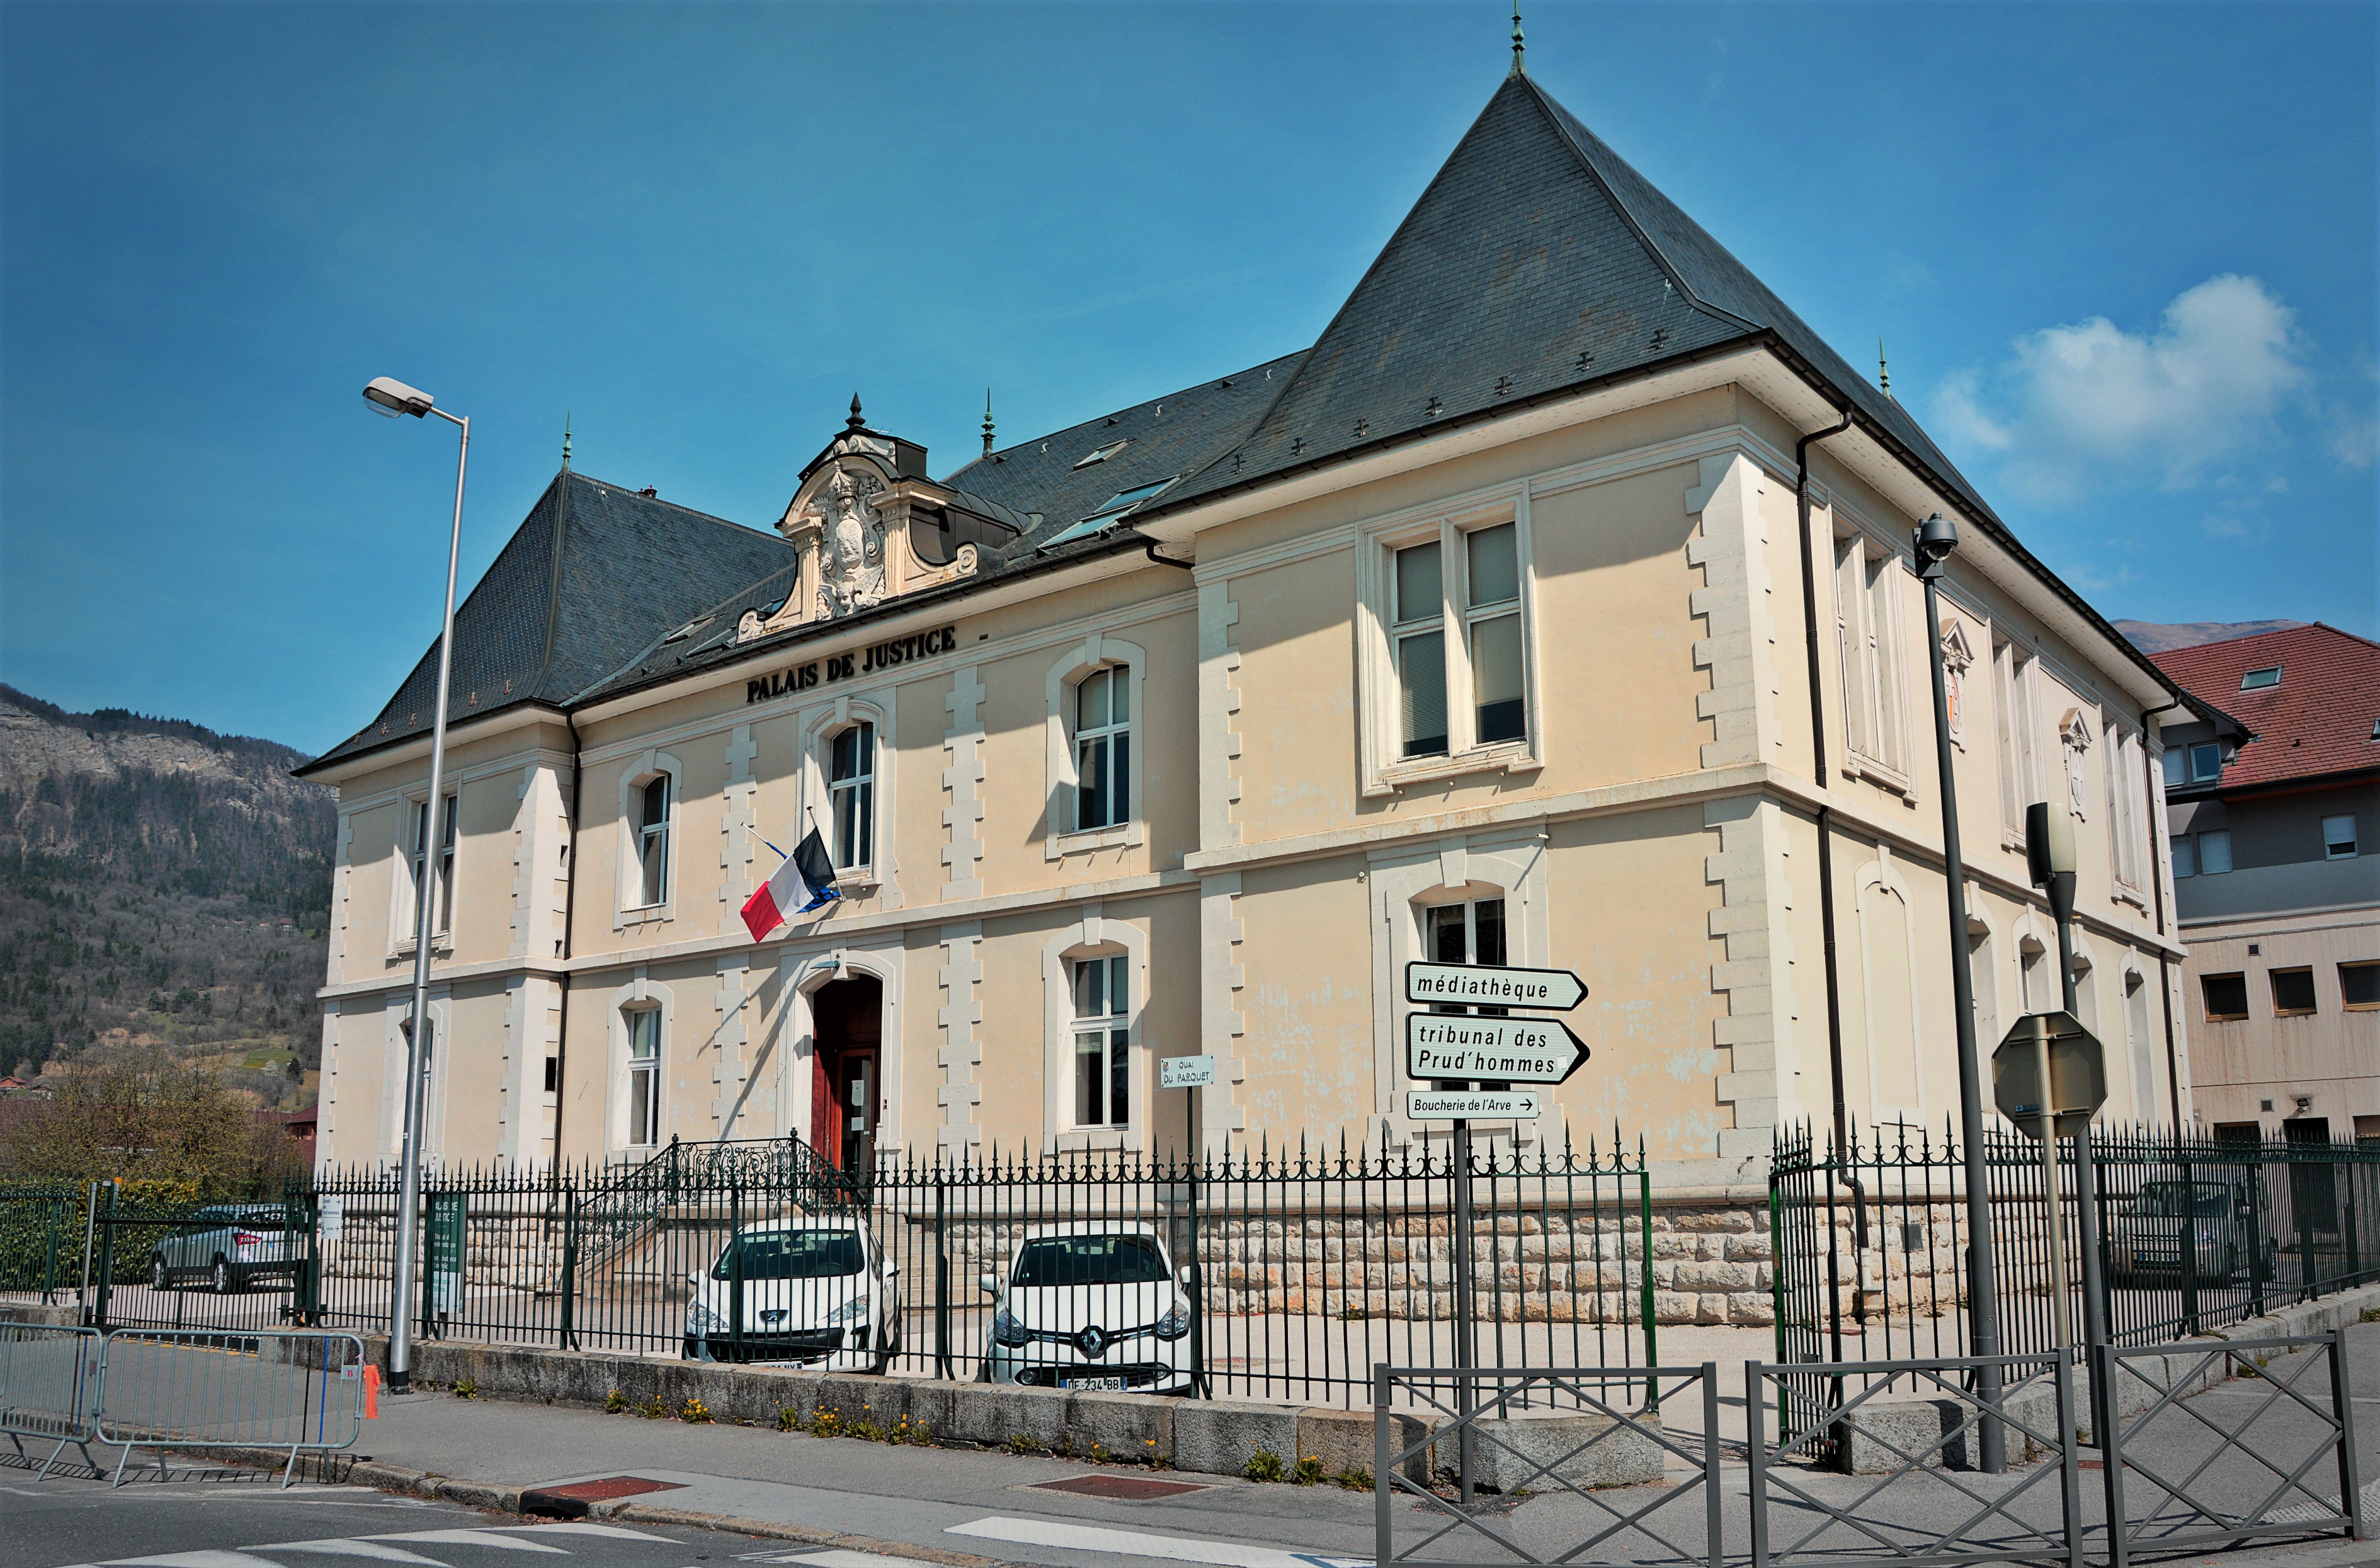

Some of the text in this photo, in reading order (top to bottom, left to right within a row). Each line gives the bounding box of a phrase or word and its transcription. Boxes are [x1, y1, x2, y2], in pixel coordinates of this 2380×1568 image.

[746, 626, 956, 703] PALAIS DE JUSTICE
[1417, 975, 1548, 1002] médiathèque
[1419, 1025, 1547, 1048] tribunal des
[1179, 1061, 1194, 1070] QUAI
[1418, 1049, 1554, 1073] Prud'hommes
[1164, 1071, 1210, 1084] DU PARQUET
[1414, 1099, 1512, 1111] Boucherie de l'Arve
